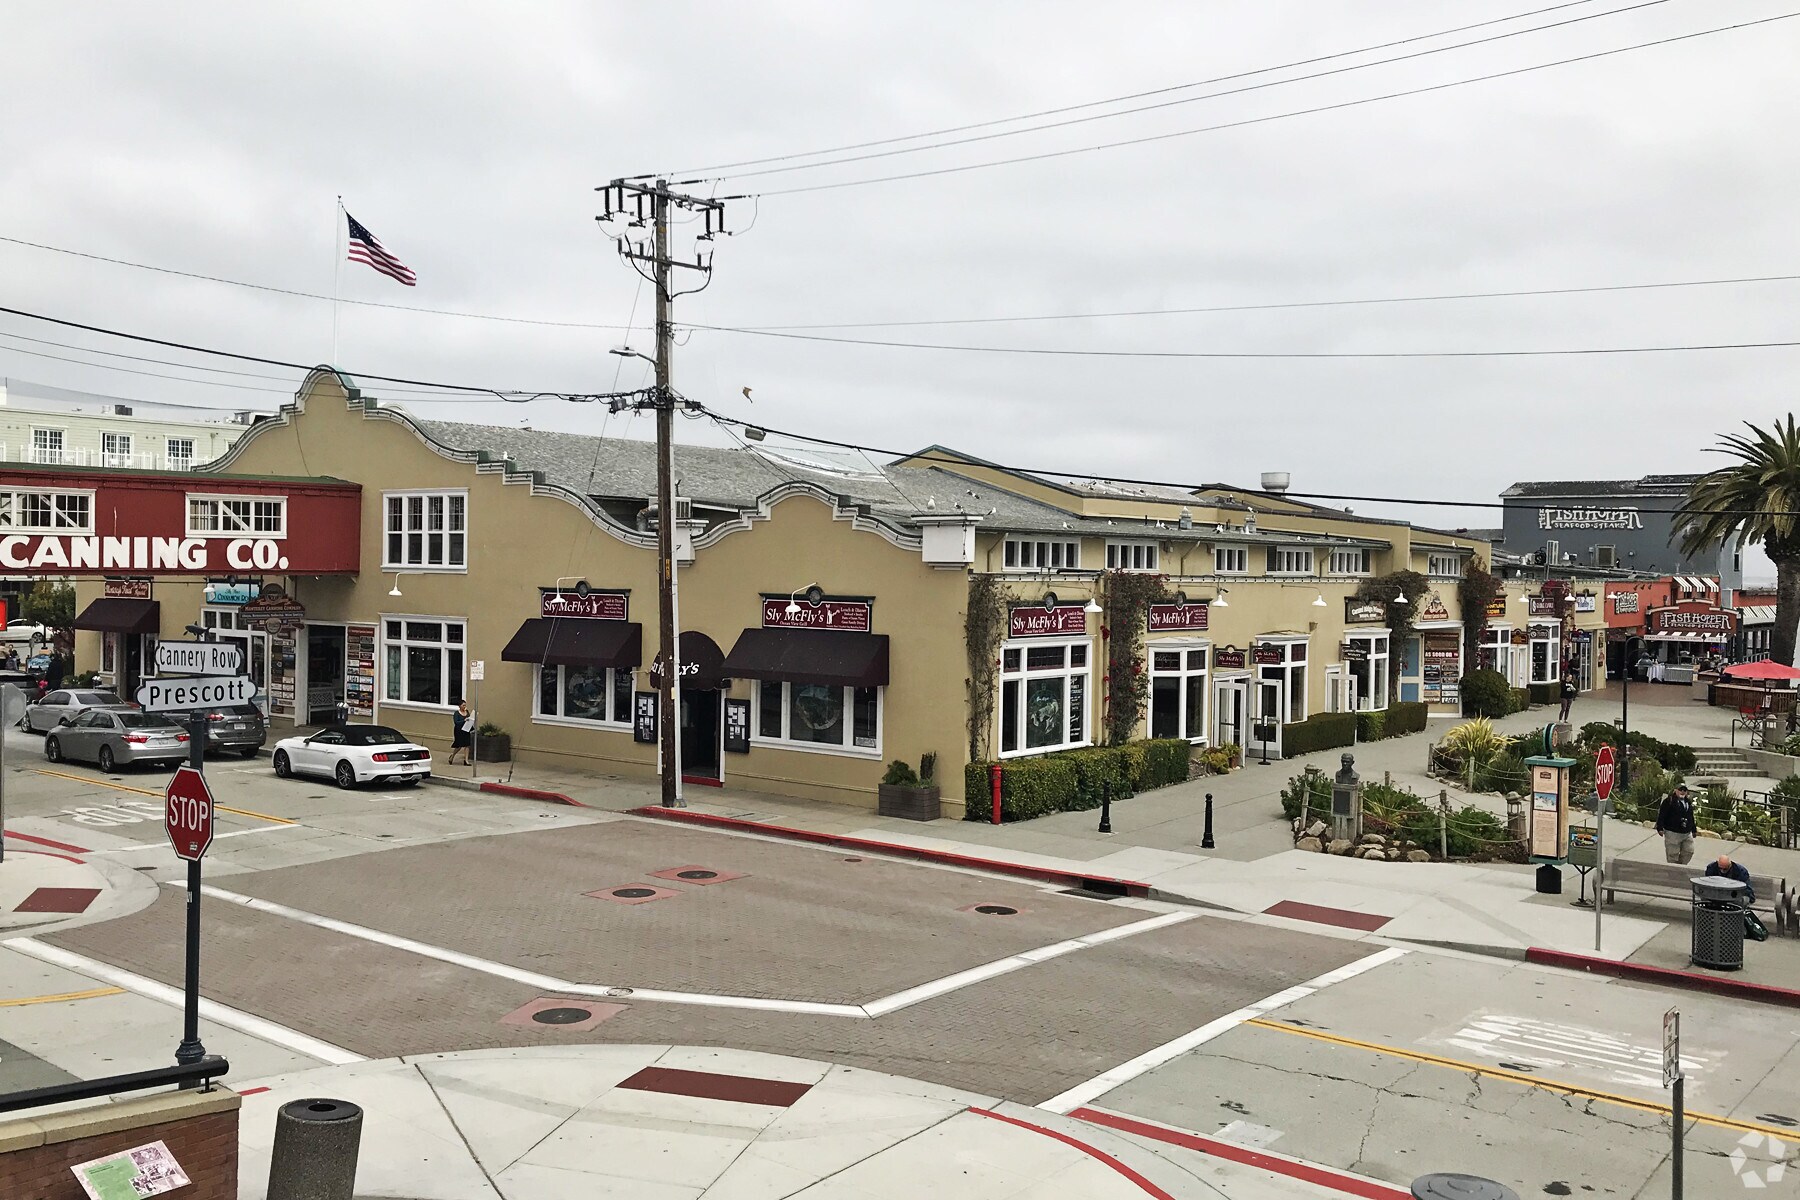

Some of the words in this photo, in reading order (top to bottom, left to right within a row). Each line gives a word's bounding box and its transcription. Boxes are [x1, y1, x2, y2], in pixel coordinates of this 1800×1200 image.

[1544, 505, 1584, 529] FISH
[1585, 506, 1643, 529] HOPPER
[0, 535, 208, 570] CANNING
[226, 538, 289, 570] CO.
[544, 600, 556, 614] Sly
[558, 600, 590, 614] McFly's
[766, 608, 781, 622] Sly
[784, 609, 824, 624] McFly's
[1013, 617, 1025, 631] Sly
[1027, 616, 1056, 630] McFly's
[1152, 613, 1161, 626] Sly
[1162, 612, 1185, 625] McFly's
[1664, 612, 1690, 627] FISH
[1692, 613, 1731, 629] HOPPER
[160, 646, 206, 672] Cannery
[212, 648, 236, 668] Row
[150, 680, 244, 706] Prescott
[1597, 764, 1612, 784] STOP
[169, 794, 209, 832] STOP
